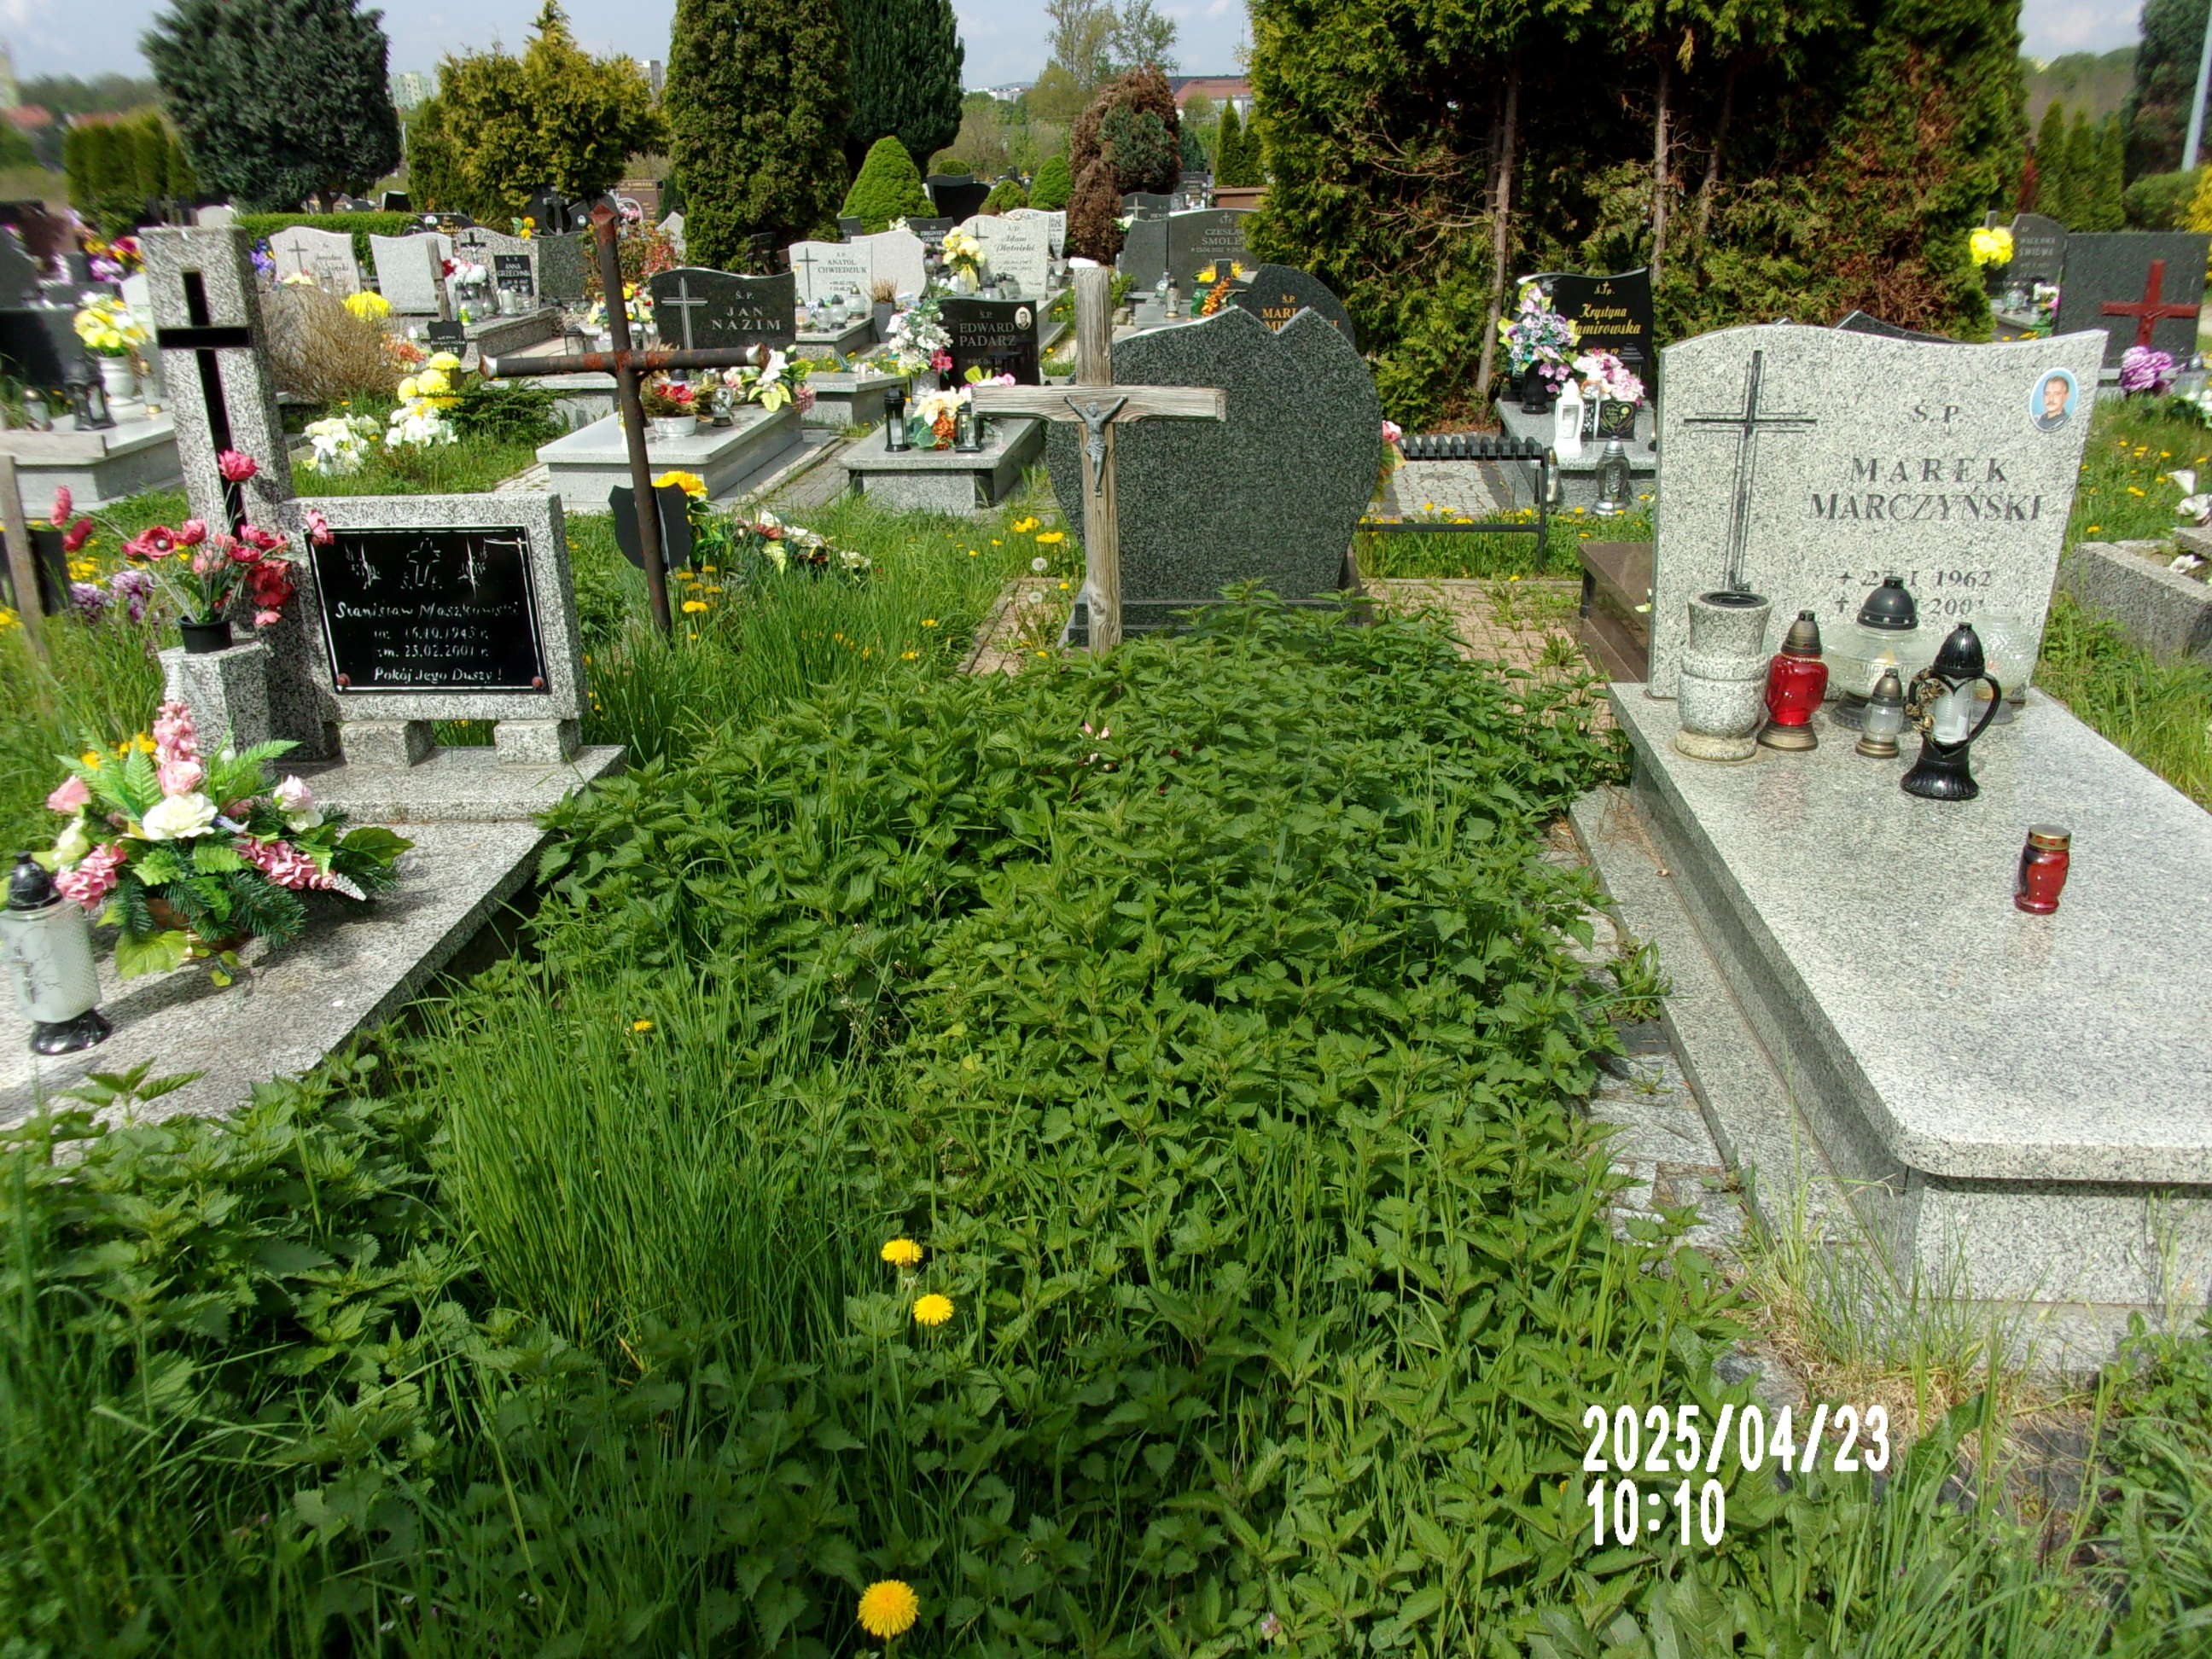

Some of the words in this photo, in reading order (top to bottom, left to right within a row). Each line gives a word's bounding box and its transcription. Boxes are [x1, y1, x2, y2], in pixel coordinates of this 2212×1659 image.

[726, 307, 764, 317] JAN
[1579, 303, 1627, 320] Krystyna
[711, 319, 781, 330] NAZIM
[959, 323, 1015, 334] EDWARD
[959, 335, 1016, 346] PADARZ
[1849, 457, 2010, 483] MAREK
[1807, 486, 2048, 521] MARCZYŃSKI
[1936, 569, 1991, 587] 1962
[374, 667, 412, 684] Pokój
[415, 669, 447, 684] Jego
[451, 668, 492, 684] Duszy
